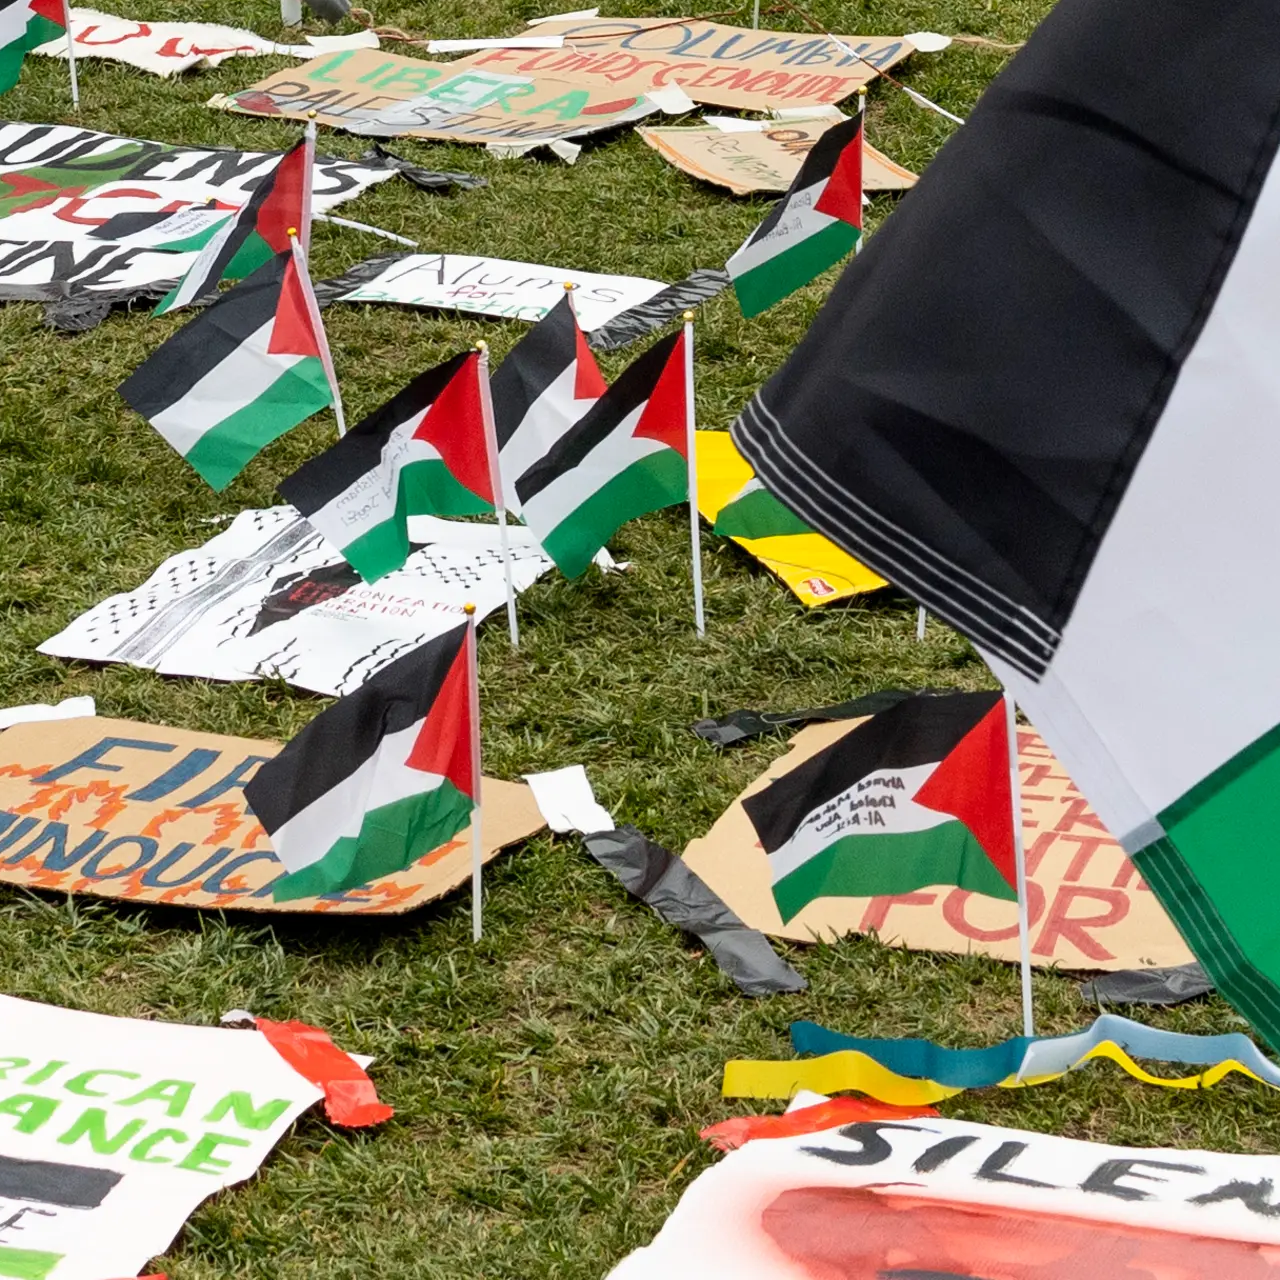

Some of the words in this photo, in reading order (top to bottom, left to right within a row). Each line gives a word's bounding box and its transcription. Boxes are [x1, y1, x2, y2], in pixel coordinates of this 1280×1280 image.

[563, 23, 904, 67] COLUMBIA
[645, 59, 864, 104] GENOCIDE
[446, 284, 515, 300] for
[859, 878, 1117, 962] FOR
